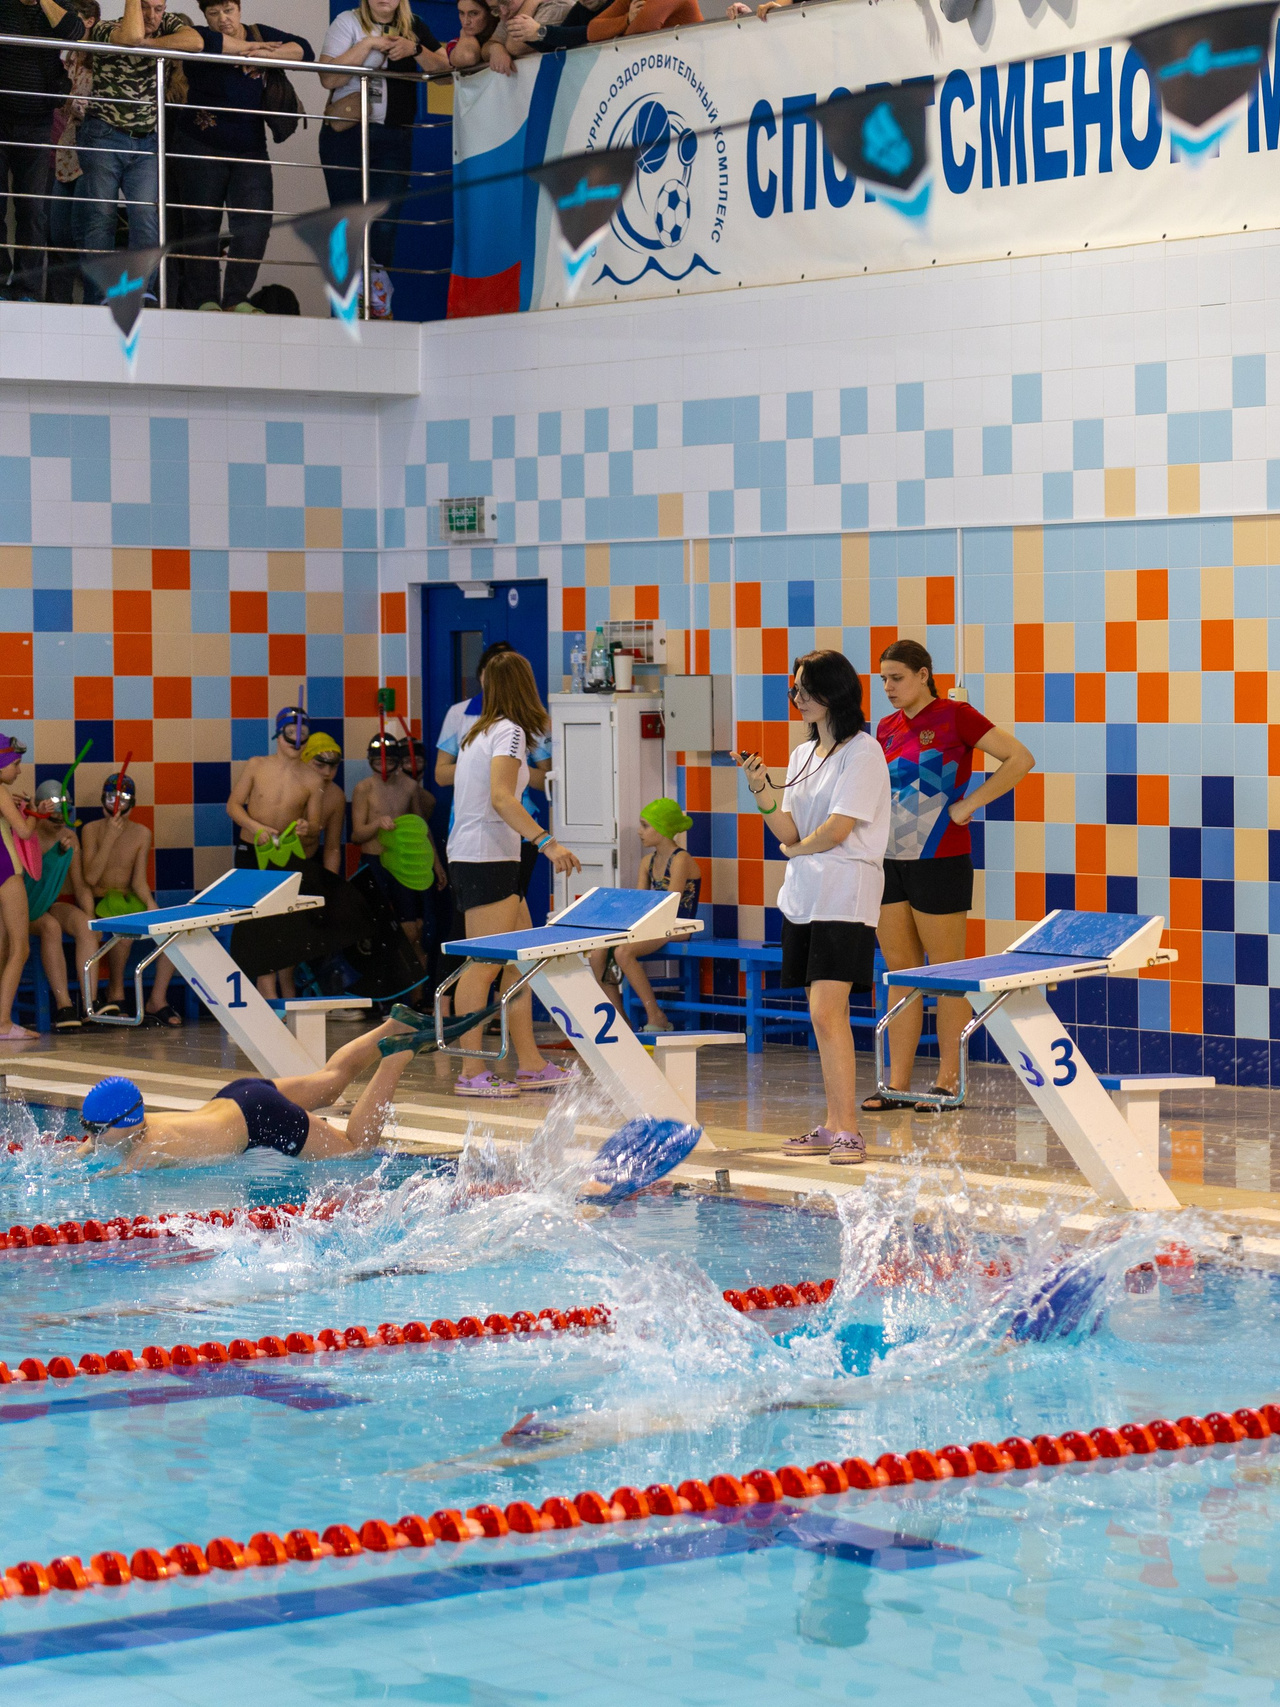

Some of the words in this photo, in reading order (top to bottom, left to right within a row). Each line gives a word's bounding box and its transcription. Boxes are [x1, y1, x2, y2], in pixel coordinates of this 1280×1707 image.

[584, 54, 720, 154] УРНО-ОЗДОРОВИТЕЛЬНЫЙ
[711, 125, 729, 243] КОМПЛЕКС
[226, 970, 248, 1008] 1
[550, 1006, 585, 1039] 2
[593, 1002, 619, 1045] 2
[1050, 1037, 1078, 1087] 3
